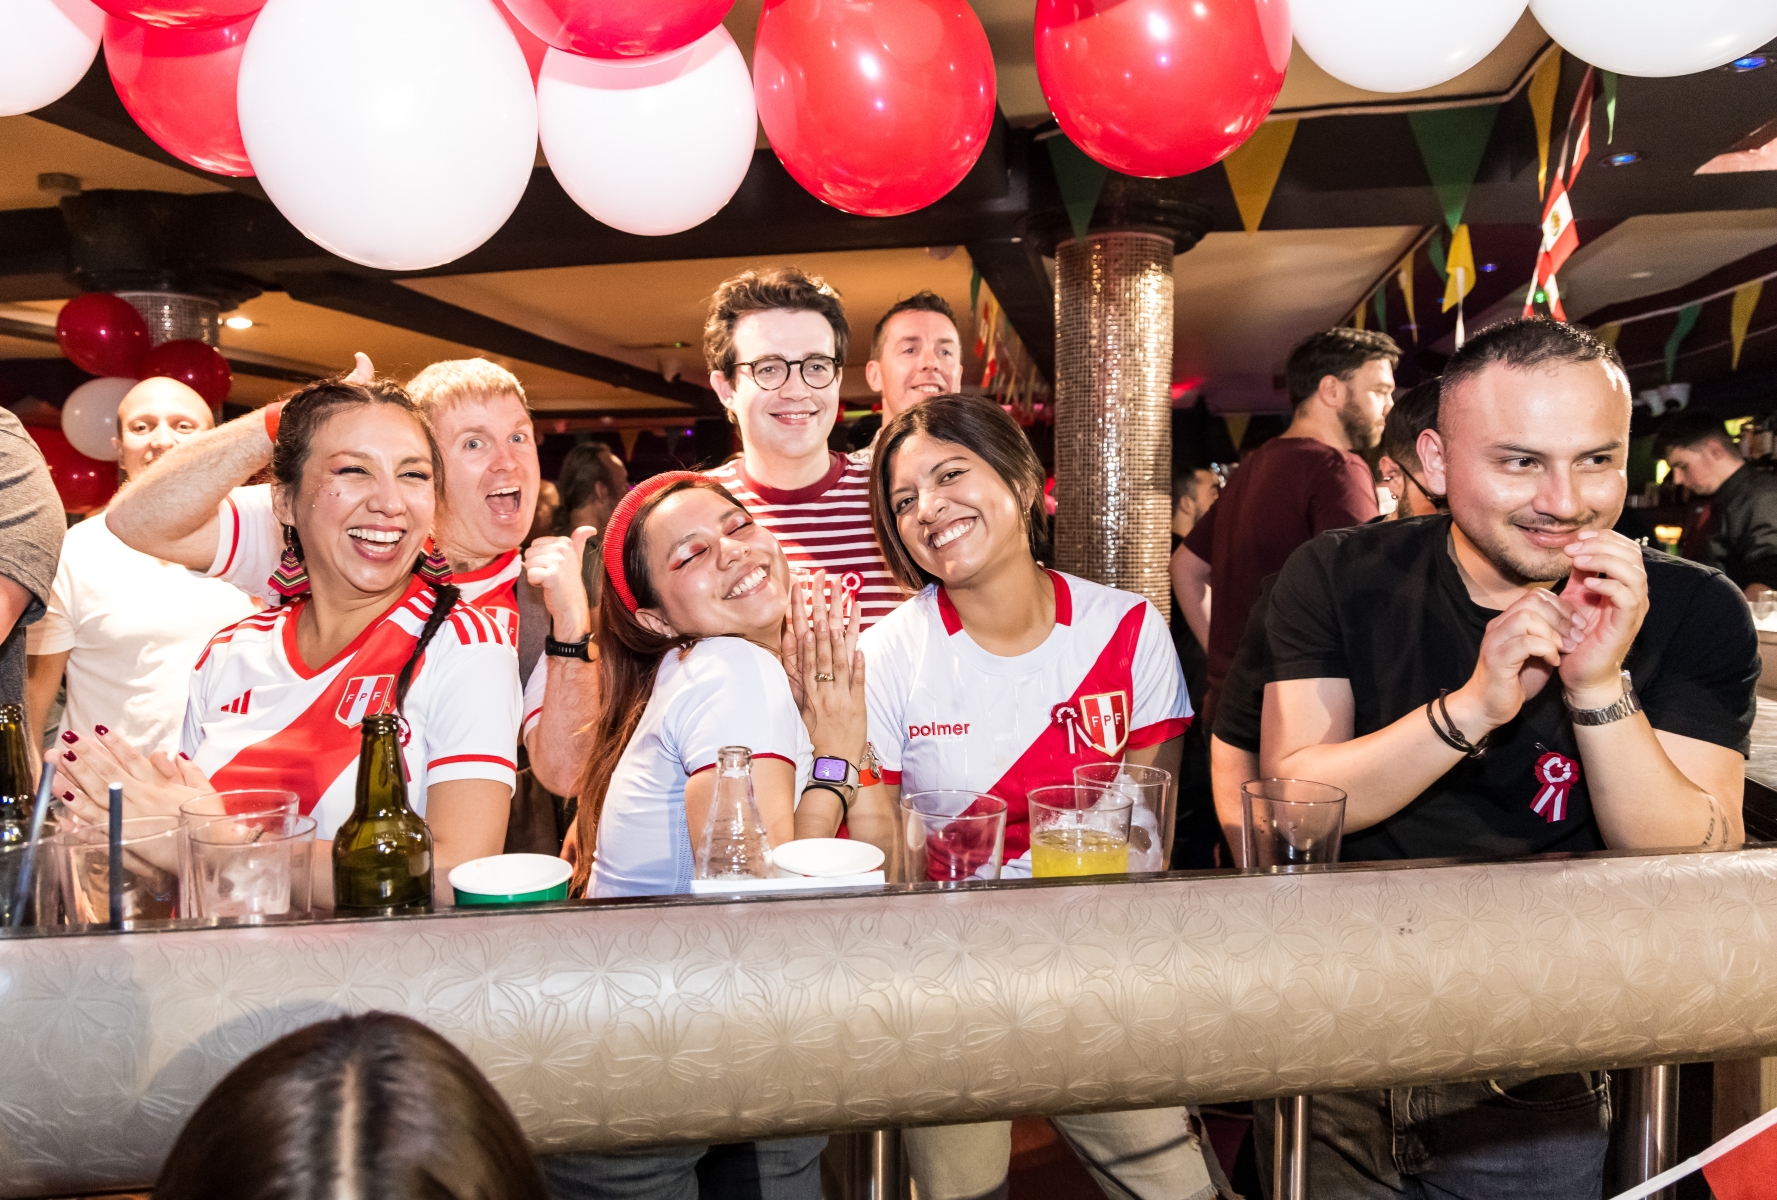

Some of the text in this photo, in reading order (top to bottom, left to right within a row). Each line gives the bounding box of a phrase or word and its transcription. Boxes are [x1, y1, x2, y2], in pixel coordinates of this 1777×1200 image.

[345, 691, 382, 703] FPF
[1091, 712, 1122, 728] FPF
[908, 721, 970, 739] polmer
